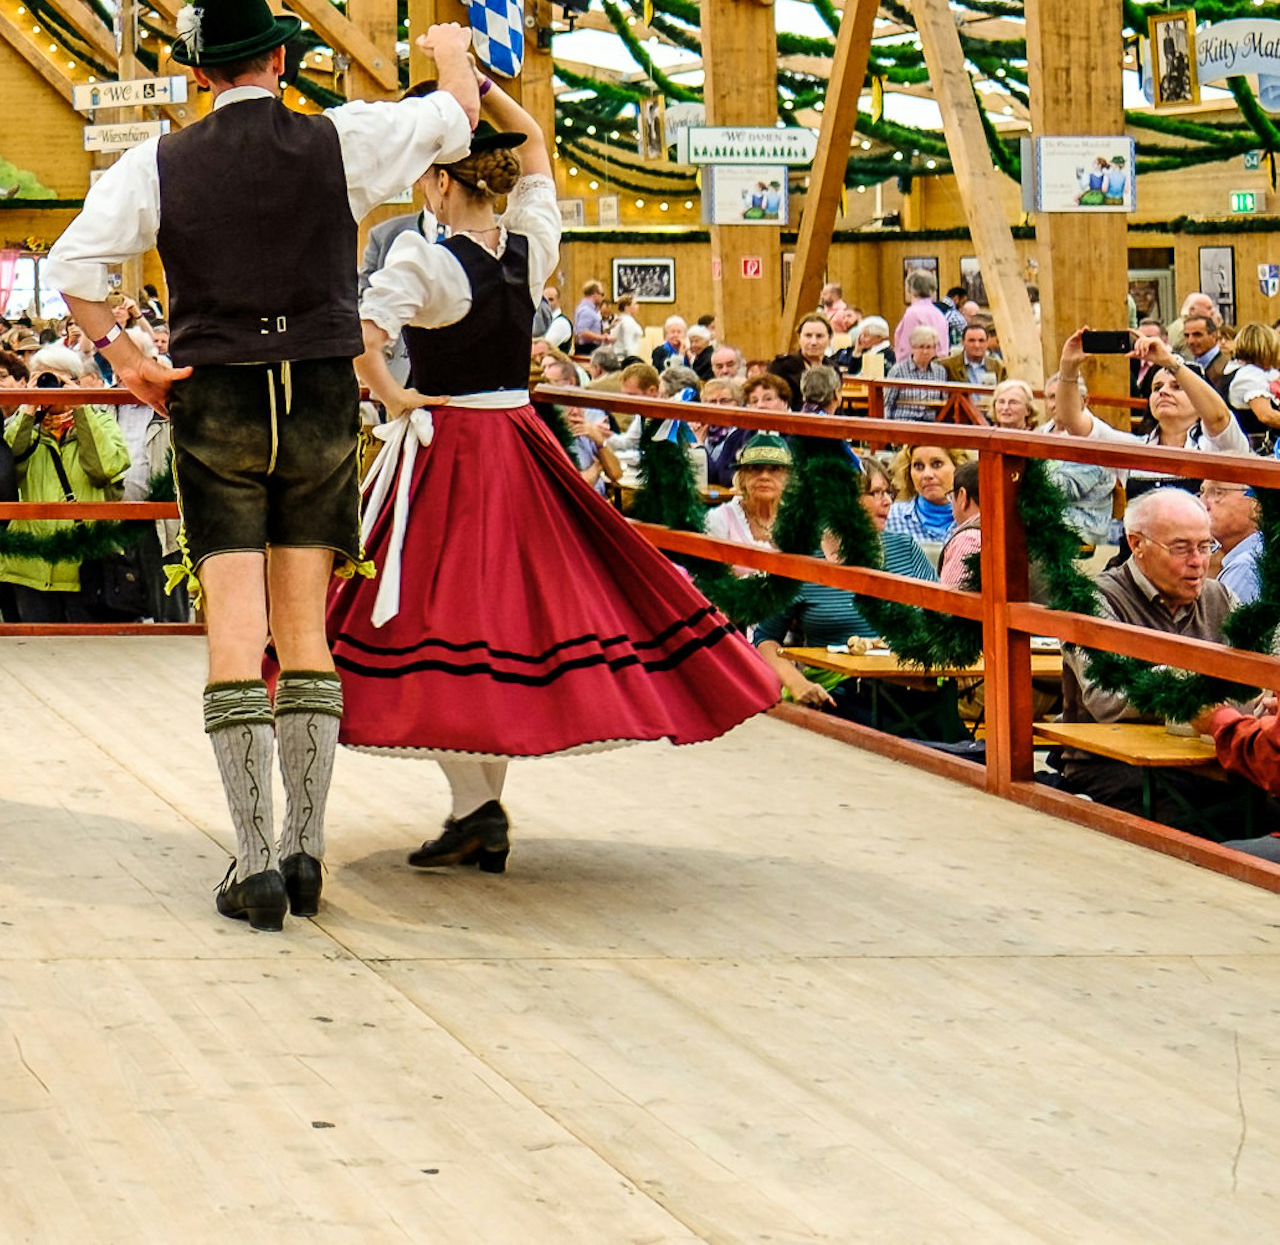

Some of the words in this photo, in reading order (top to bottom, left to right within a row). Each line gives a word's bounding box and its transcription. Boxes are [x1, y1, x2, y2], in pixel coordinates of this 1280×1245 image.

[1198, 37, 1239, 70] Kitty
[104, 84, 132, 102] WC
[722, 130, 746, 142] WC
[1244, 154, 1258, 168] 04
